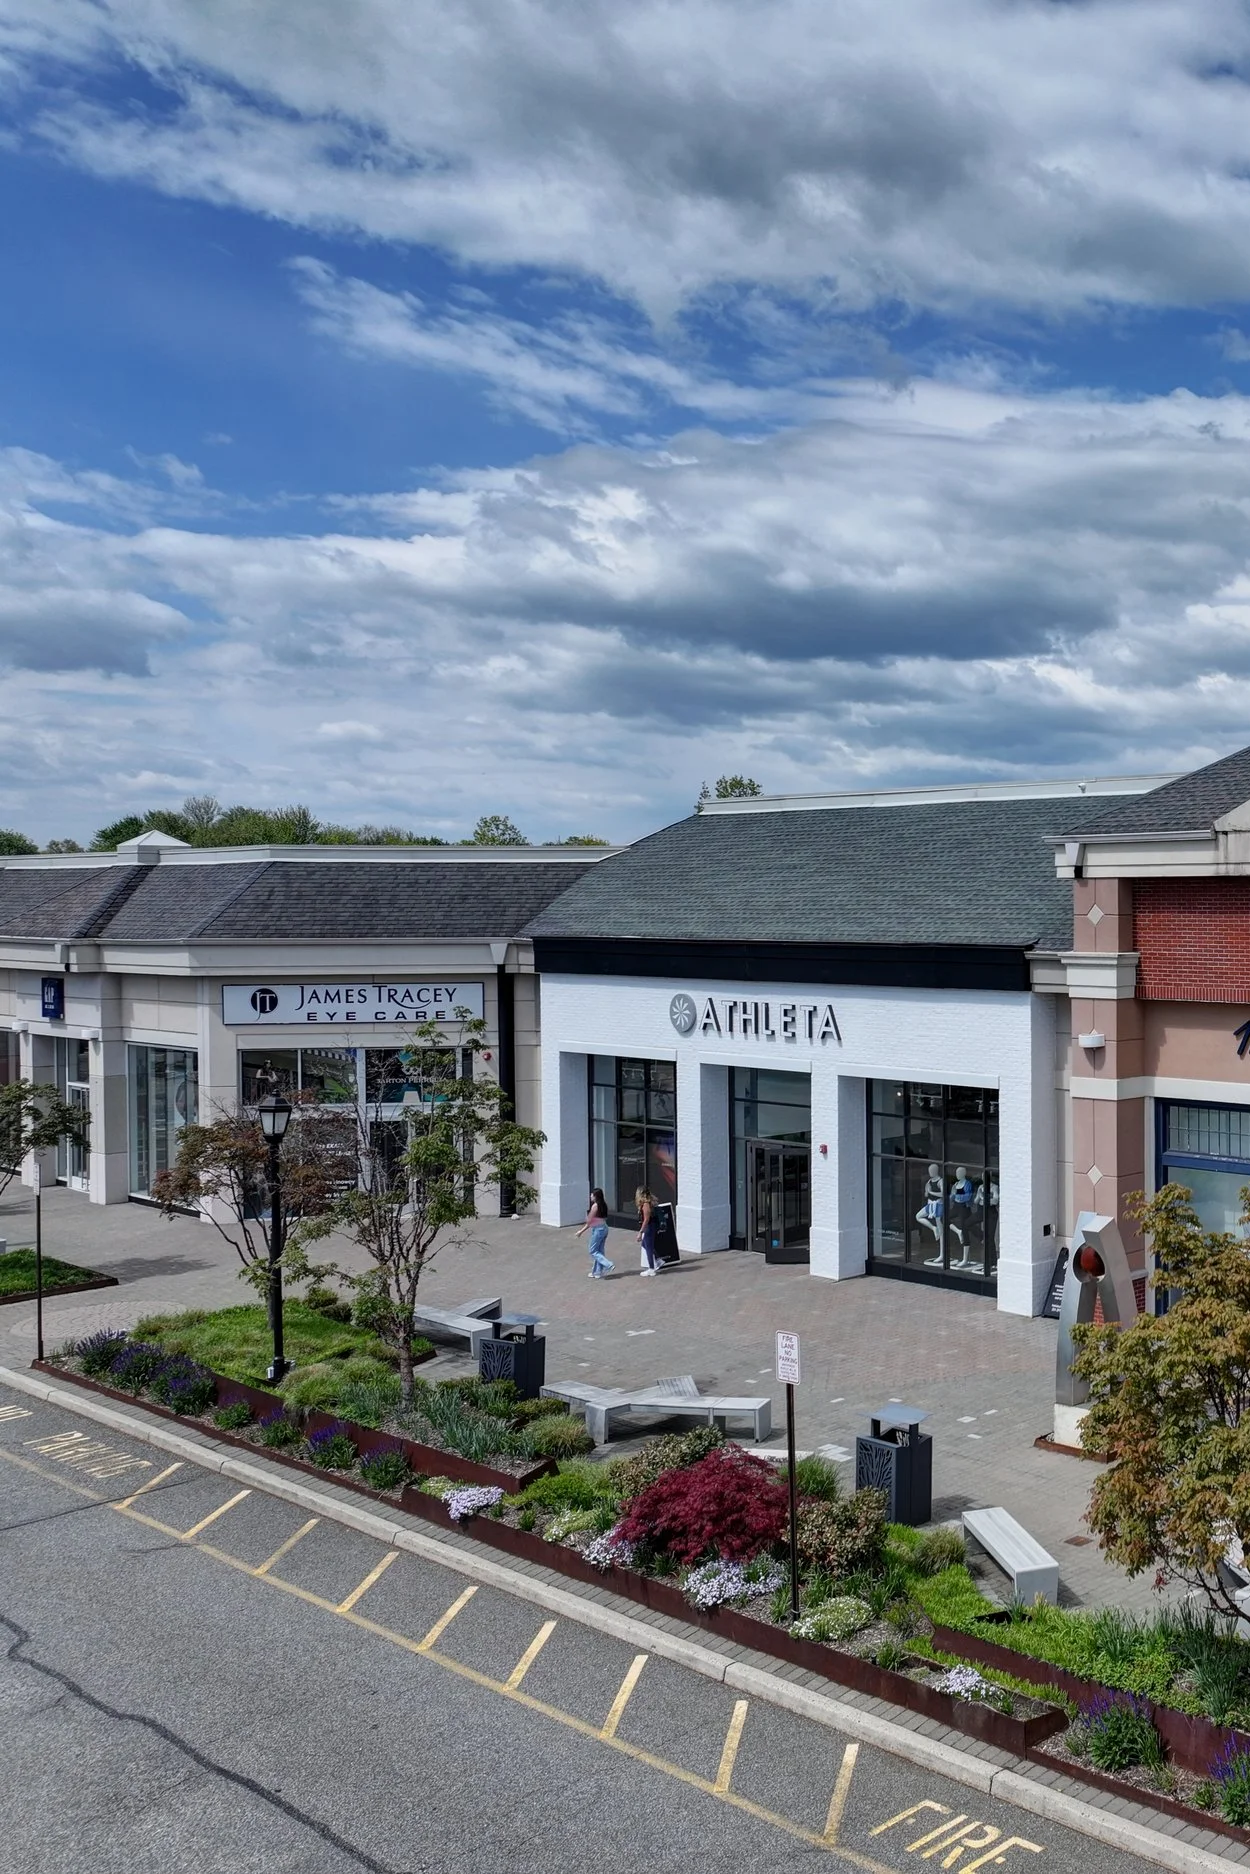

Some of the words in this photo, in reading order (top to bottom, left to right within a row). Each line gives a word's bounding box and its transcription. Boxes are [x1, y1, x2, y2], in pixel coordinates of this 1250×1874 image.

[295, 985, 367, 1011] JAMES
[372, 985, 457, 1010] TRACEY
[306, 1012, 357, 1021] EYE
[374, 1010, 446, 1020] CARE
[699, 997, 842, 1041] ATHLETA
[782, 1335, 793, 1343] FIRE
[781, 1342, 795, 1350] LANE
[779, 1355, 798, 1365] PARKING
[867, 1799, 1045, 1874] FIRE
